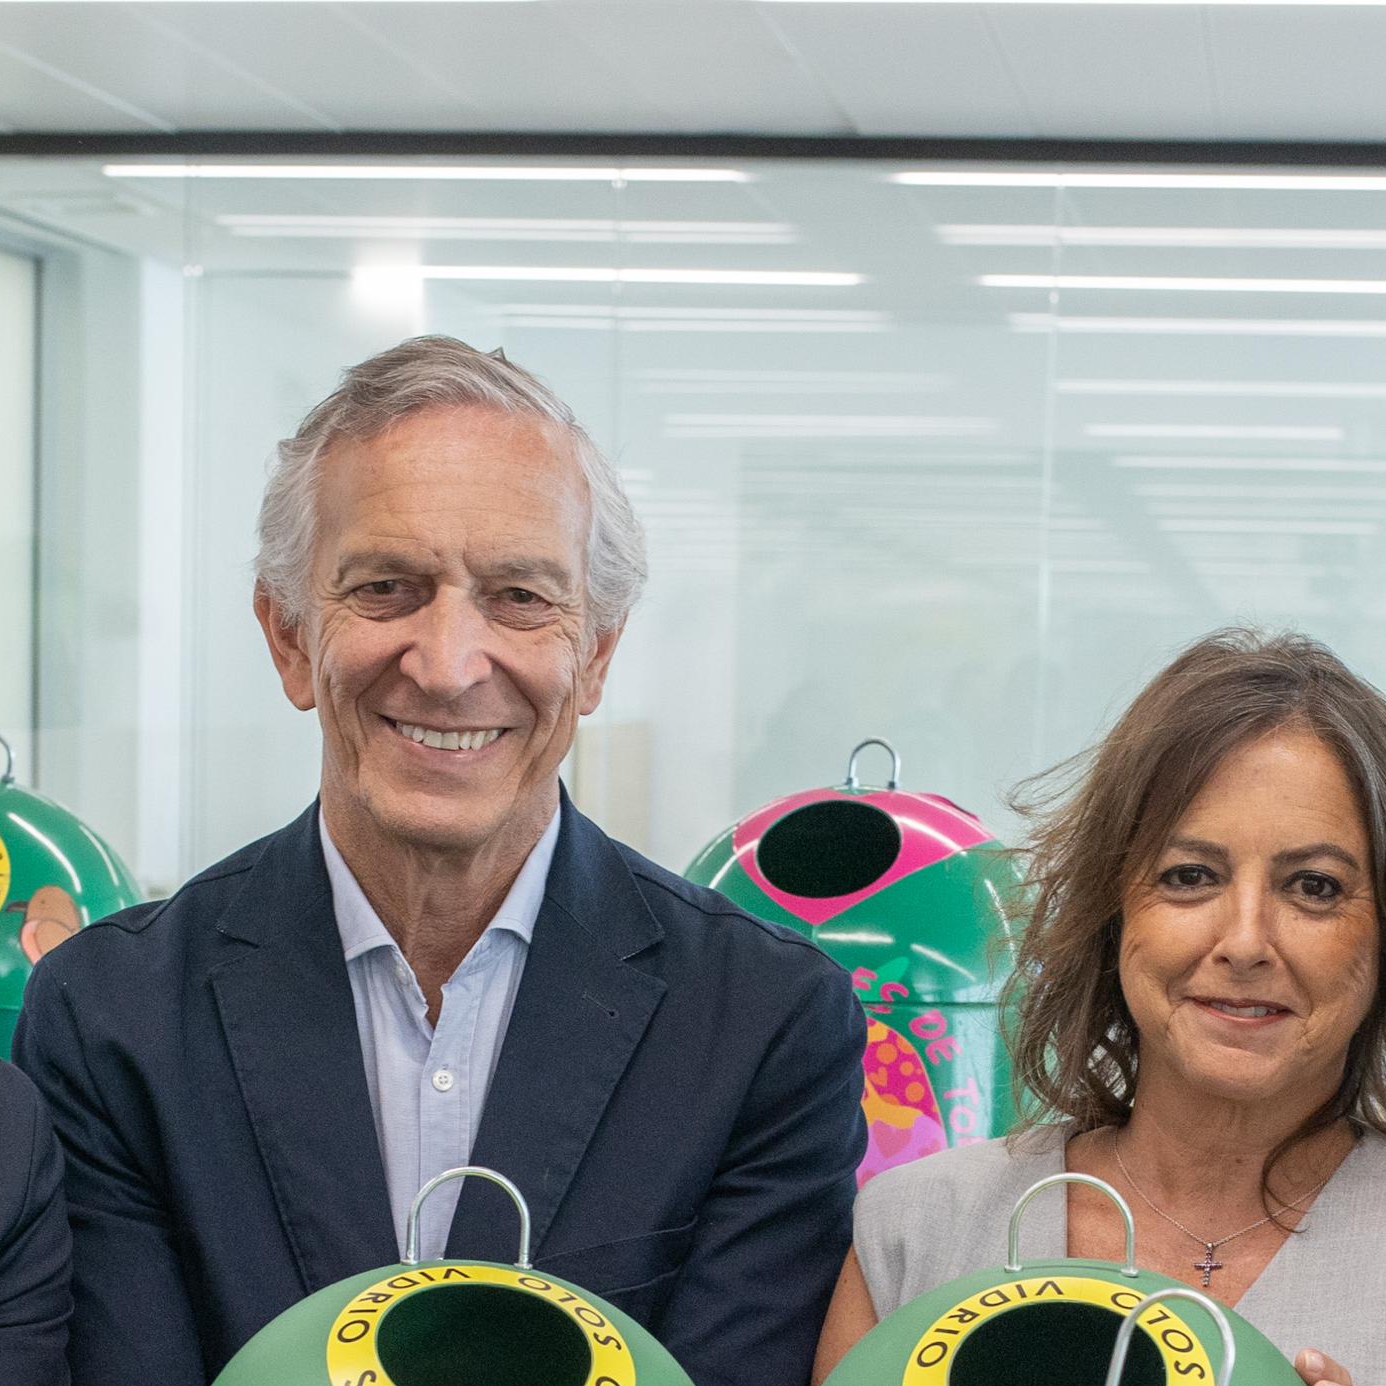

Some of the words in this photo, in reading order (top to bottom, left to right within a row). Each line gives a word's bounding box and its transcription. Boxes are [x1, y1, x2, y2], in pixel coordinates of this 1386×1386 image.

[909, 1009, 962, 1066] DE
[337, 1267, 470, 1343] VIDRIO
[518, 1276, 622, 1352] SOLO
[917, 1280, 1064, 1368] VIDRIO
[1110, 1291, 1206, 1381] SOLO
